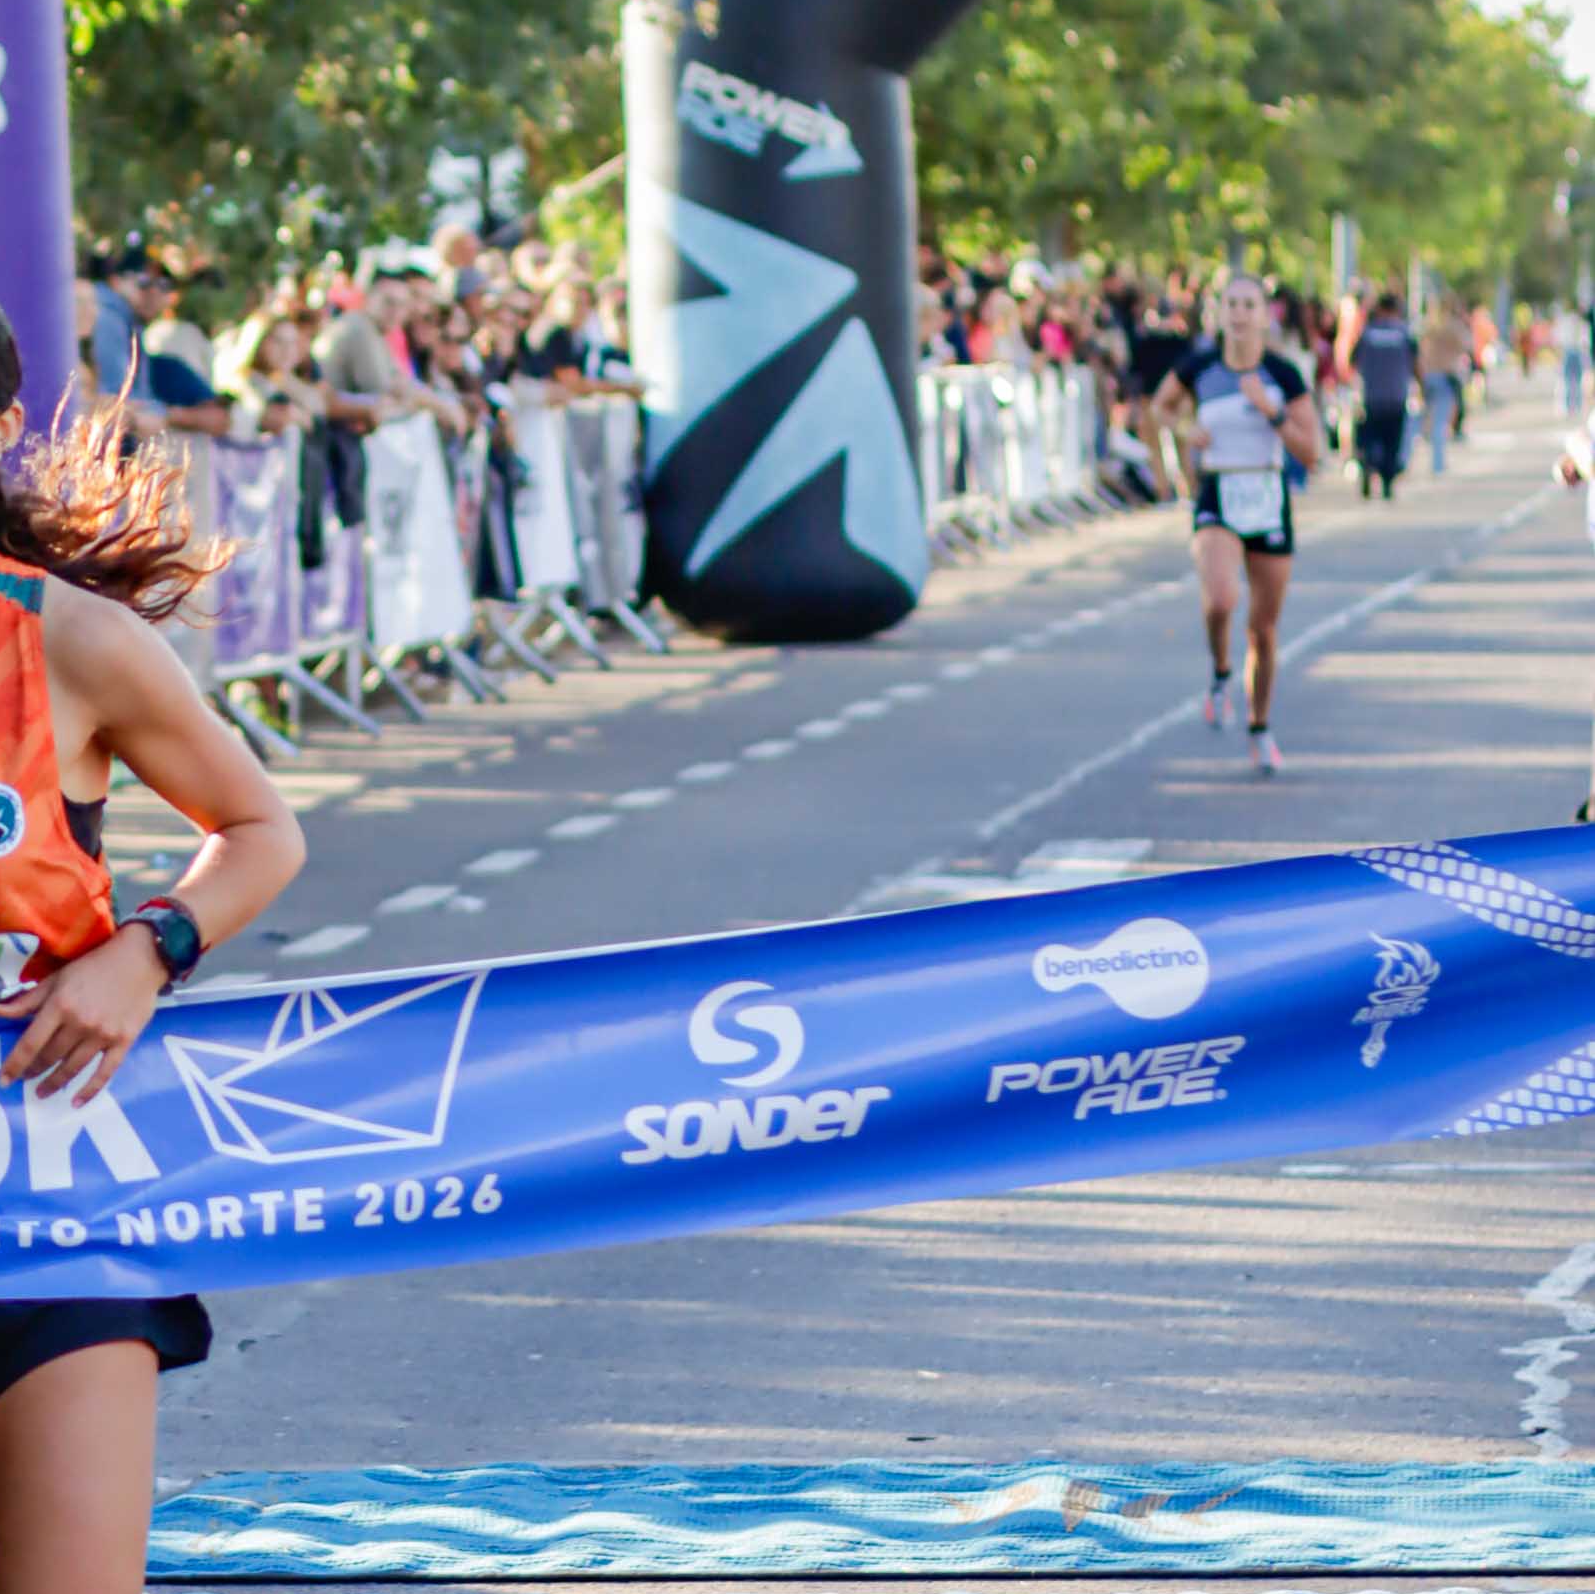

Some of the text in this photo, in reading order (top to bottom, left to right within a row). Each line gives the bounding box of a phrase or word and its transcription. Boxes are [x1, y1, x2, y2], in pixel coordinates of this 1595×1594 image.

[1043, 947, 1200, 978] benedictino
[986, 1035, 1246, 1103] POWER
[115, 1184, 326, 1248] NORTE
[353, 1172, 504, 1228] 2026
